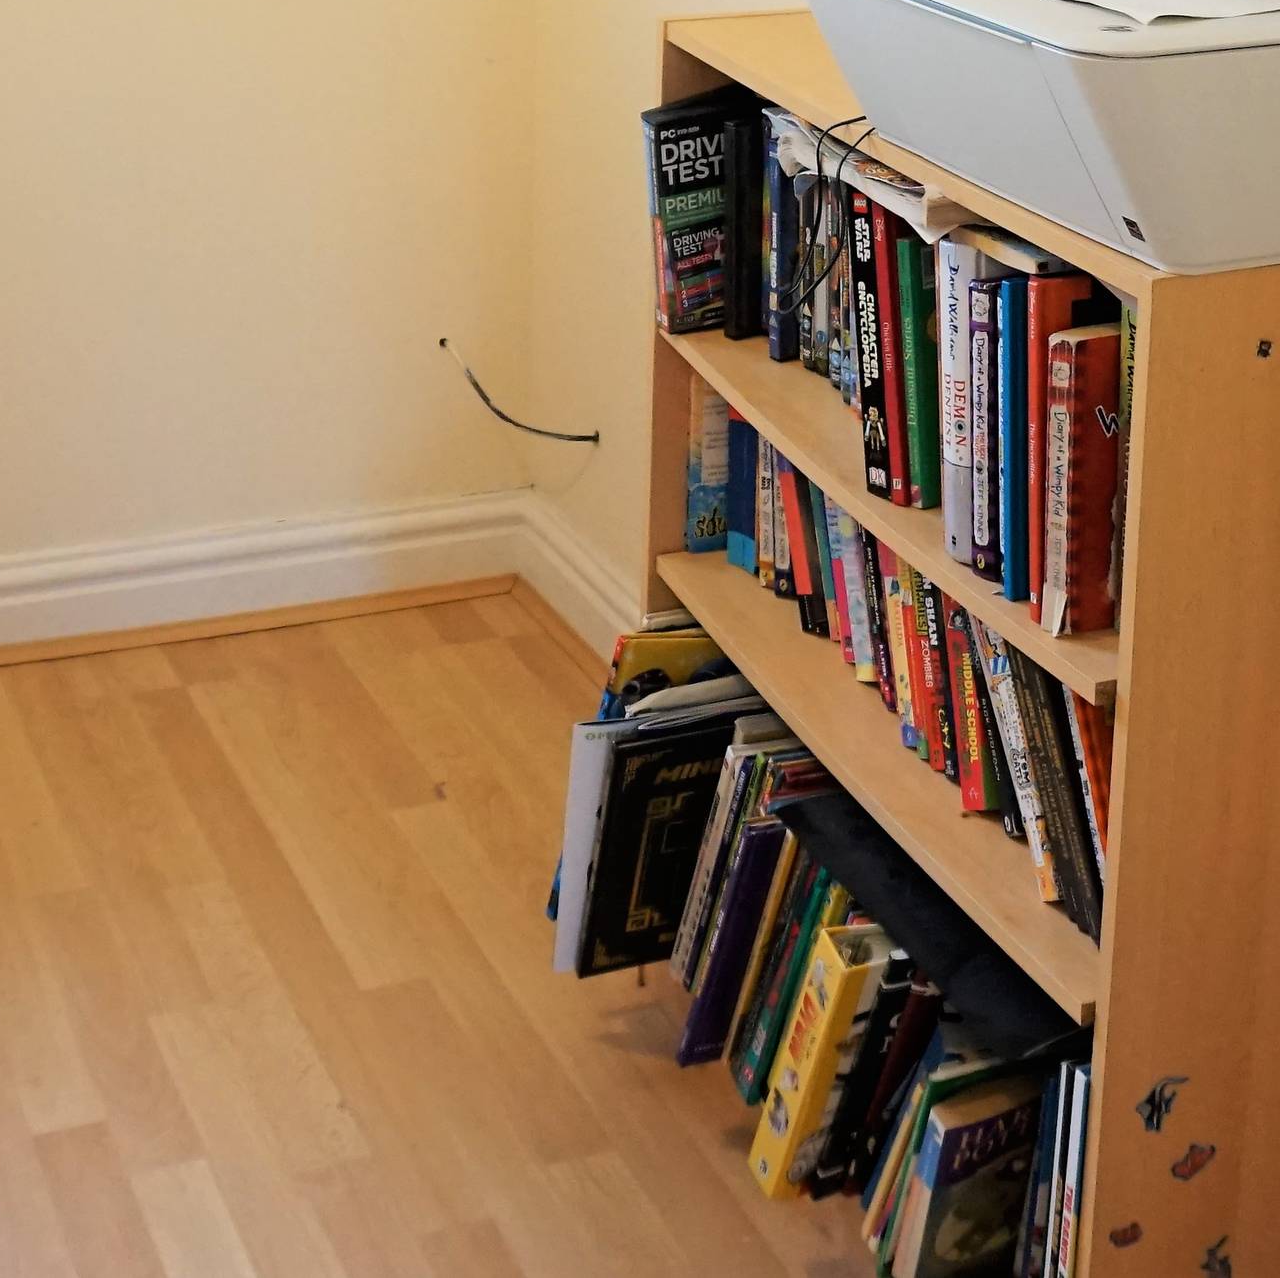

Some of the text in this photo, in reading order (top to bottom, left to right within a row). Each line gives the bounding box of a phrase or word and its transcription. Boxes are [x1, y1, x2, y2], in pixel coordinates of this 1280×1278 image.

[660, 129, 676, 140] PC
[662, 154, 723, 186] TEST
[673, 227, 720, 249] DRIVING
[675, 242, 703, 258] TEST
[854, 218, 866, 262] WARS
[862, 221, 871, 262] STAR
[677, 258, 691, 269] ALL
[682, 299, 688, 308] 3
[857, 280, 873, 388] ENCYCLOPEDIA
[865, 293, 880, 379] CHARACTER
[904, 316, 913, 360] Stories
[973, 336, 985, 366] Diary
[905, 365, 917, 425] Dinosaur
[944, 372, 952, 449] DENTIST
[973, 382, 985, 412] Wimpy
[975, 413, 985, 429] Kid
[1054, 411, 1068, 443] Diary
[1050, 464, 1065, 497] Wimpy
[974, 504, 985, 542] KINNEY
[1055, 499, 1067, 518] Kid
[924, 597, 940, 647] SHAN
[920, 639, 934, 688] ZOMBIES
[961, 652, 975, 706] MIDDLE
[964, 708, 977, 763] SCHOOL
[1021, 753, 1031, 784] TOM
